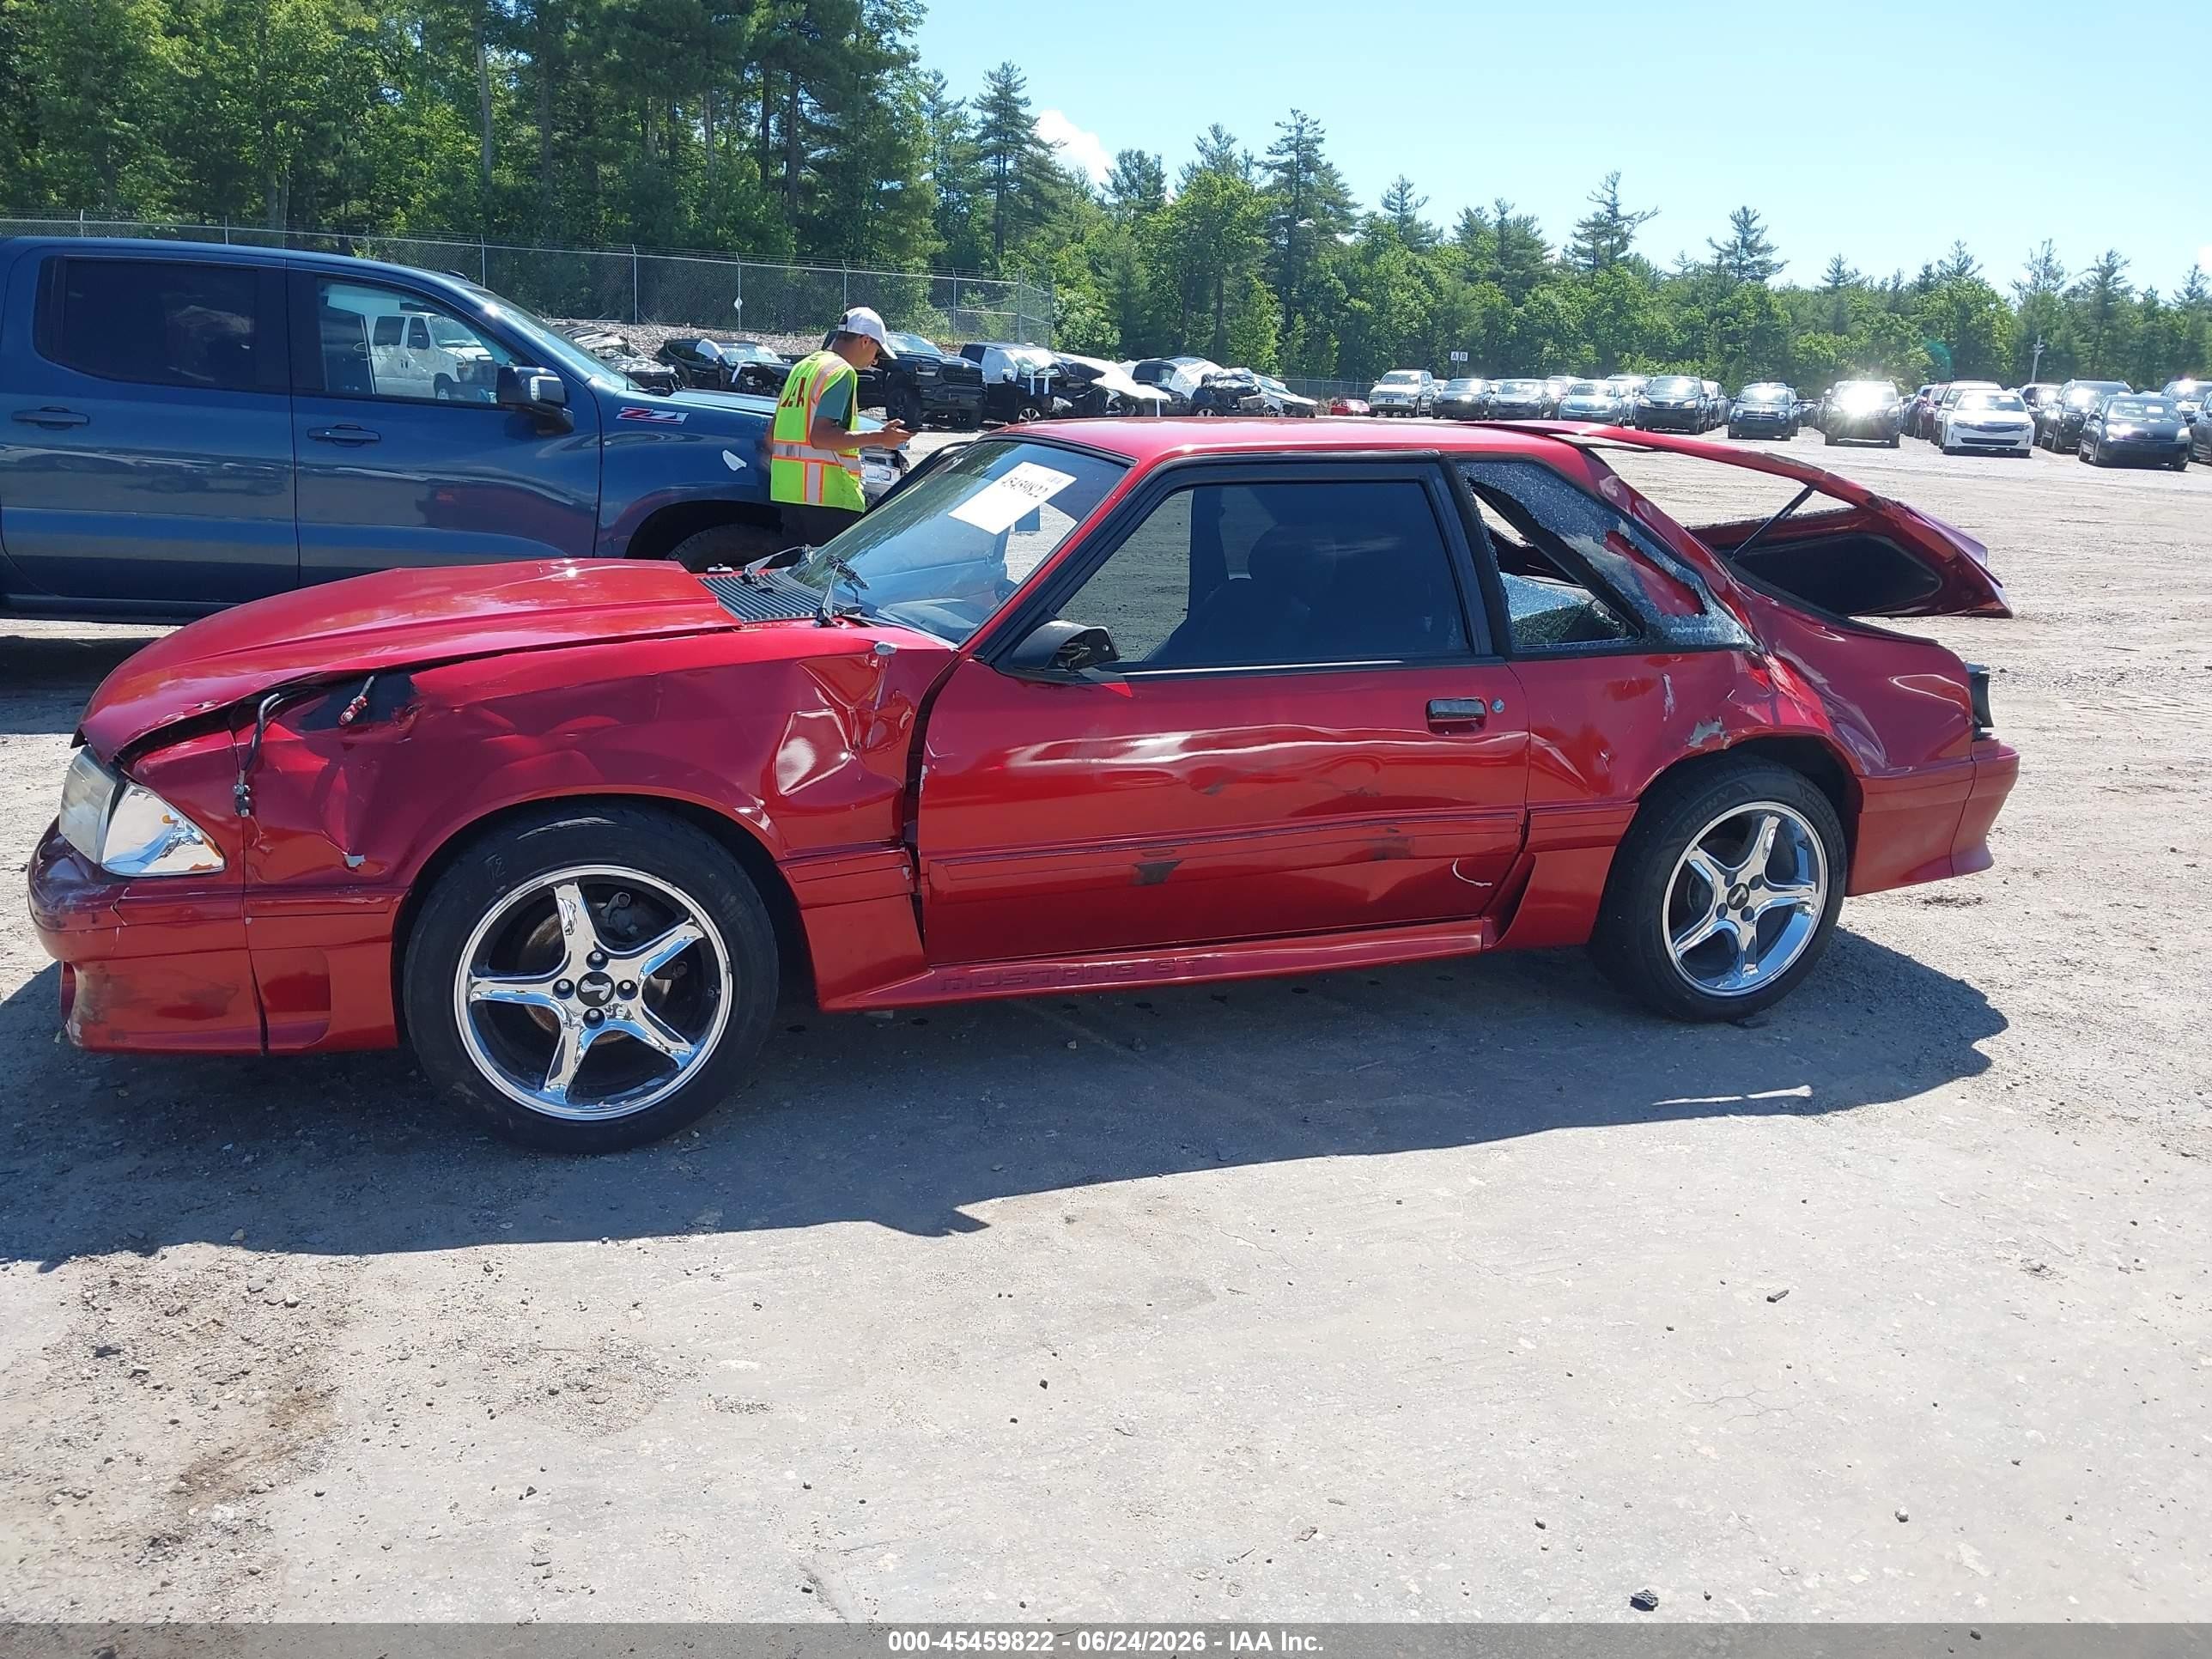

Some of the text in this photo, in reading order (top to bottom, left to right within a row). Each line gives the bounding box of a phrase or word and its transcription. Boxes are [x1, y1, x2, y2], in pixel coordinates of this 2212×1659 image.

[617, 406, 689, 425] Z71
[940, 955, 1199, 991] MUSTANG GT
